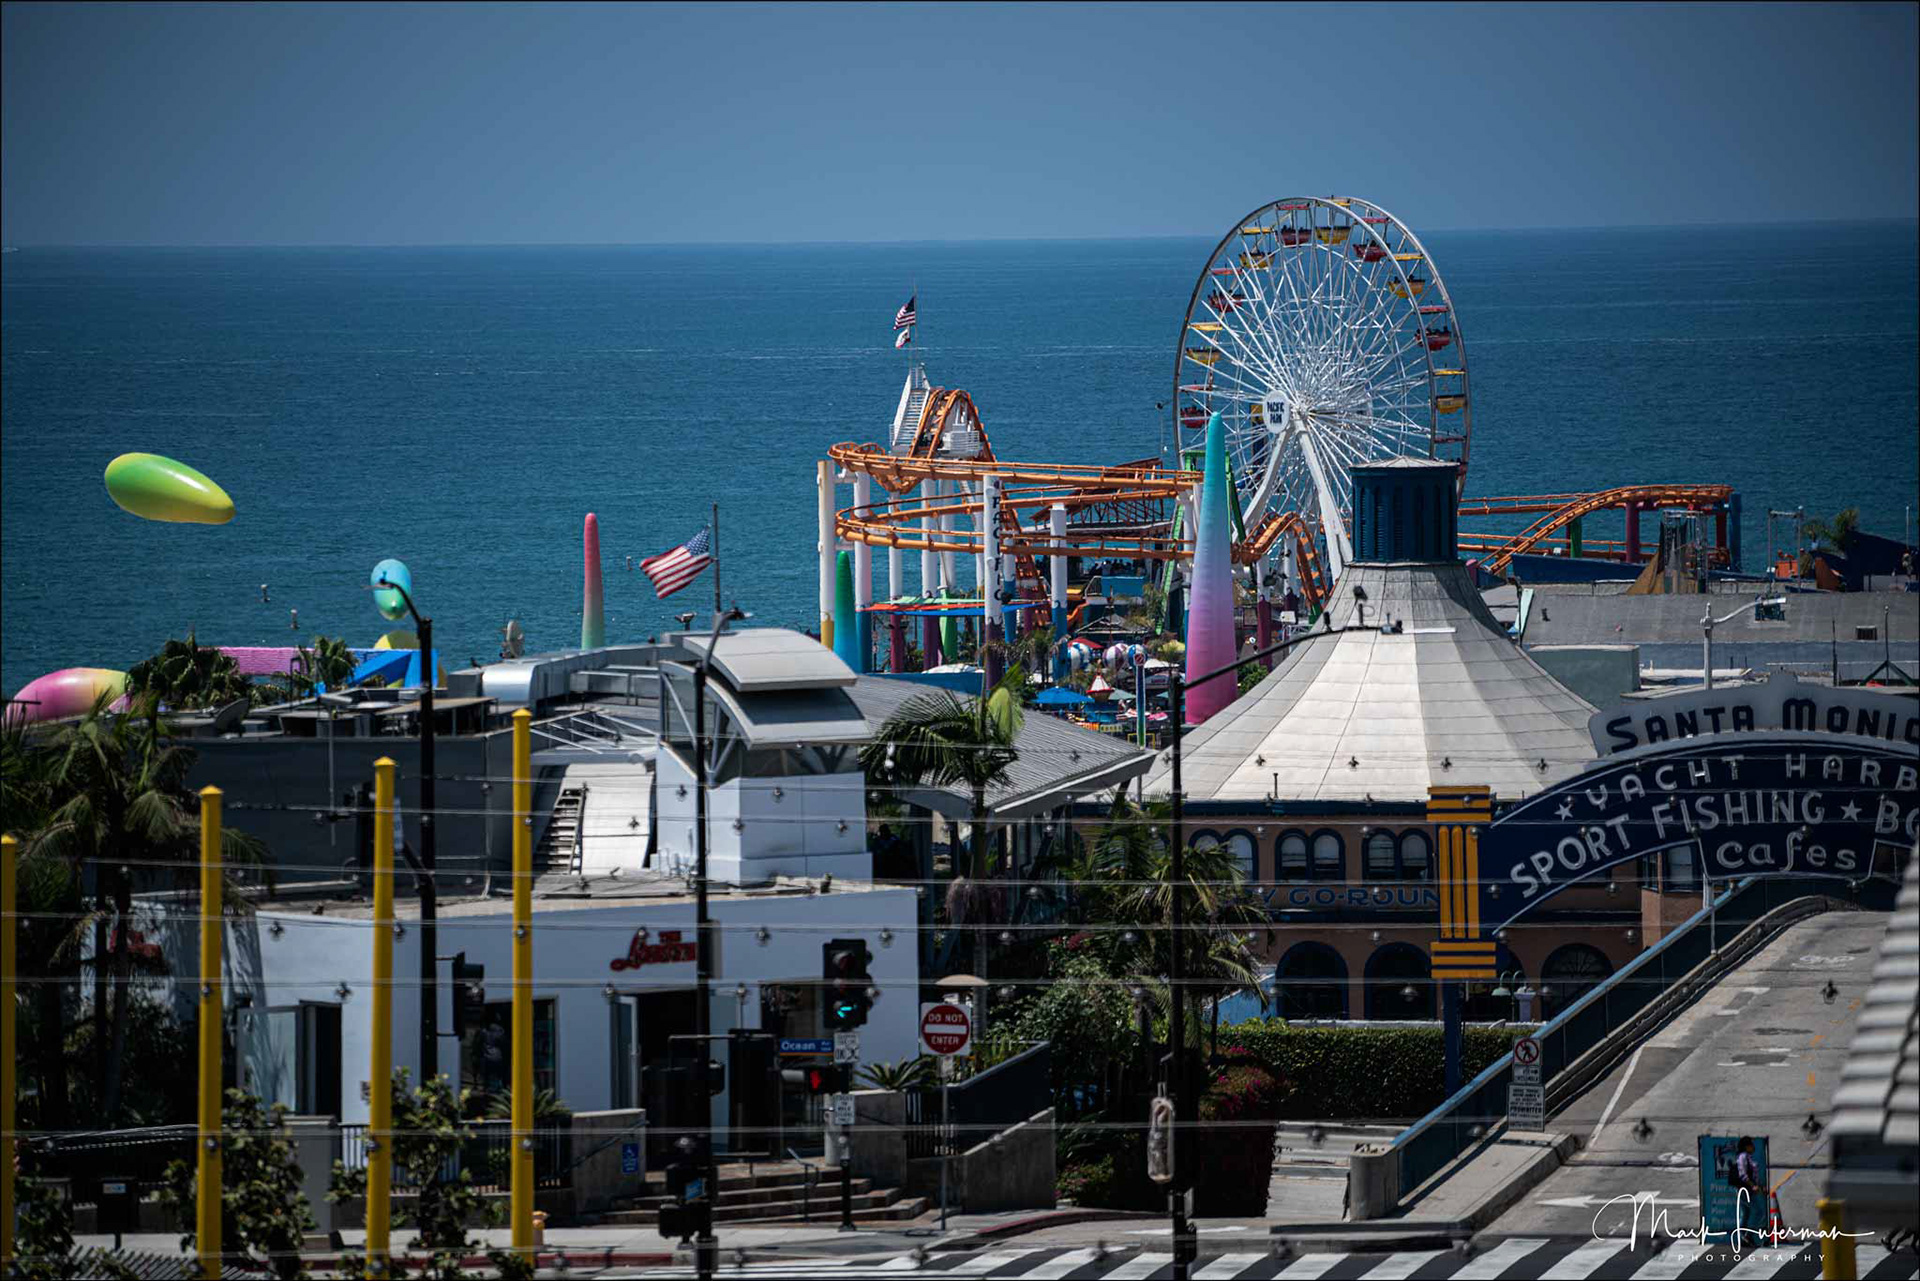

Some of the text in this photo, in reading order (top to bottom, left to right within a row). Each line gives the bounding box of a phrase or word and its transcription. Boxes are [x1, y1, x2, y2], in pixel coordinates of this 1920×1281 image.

[1606, 705, 1755, 754] SANTA
[1584, 754, 1745, 811] YACHT
[1509, 813, 1631, 899] SPORT
[1651, 789, 1826, 839] FISHING
[928, 1013, 964, 1023] DO NOT
[781, 1040, 817, 1051] Ocean
[931, 1035, 960, 1046] ENTER
